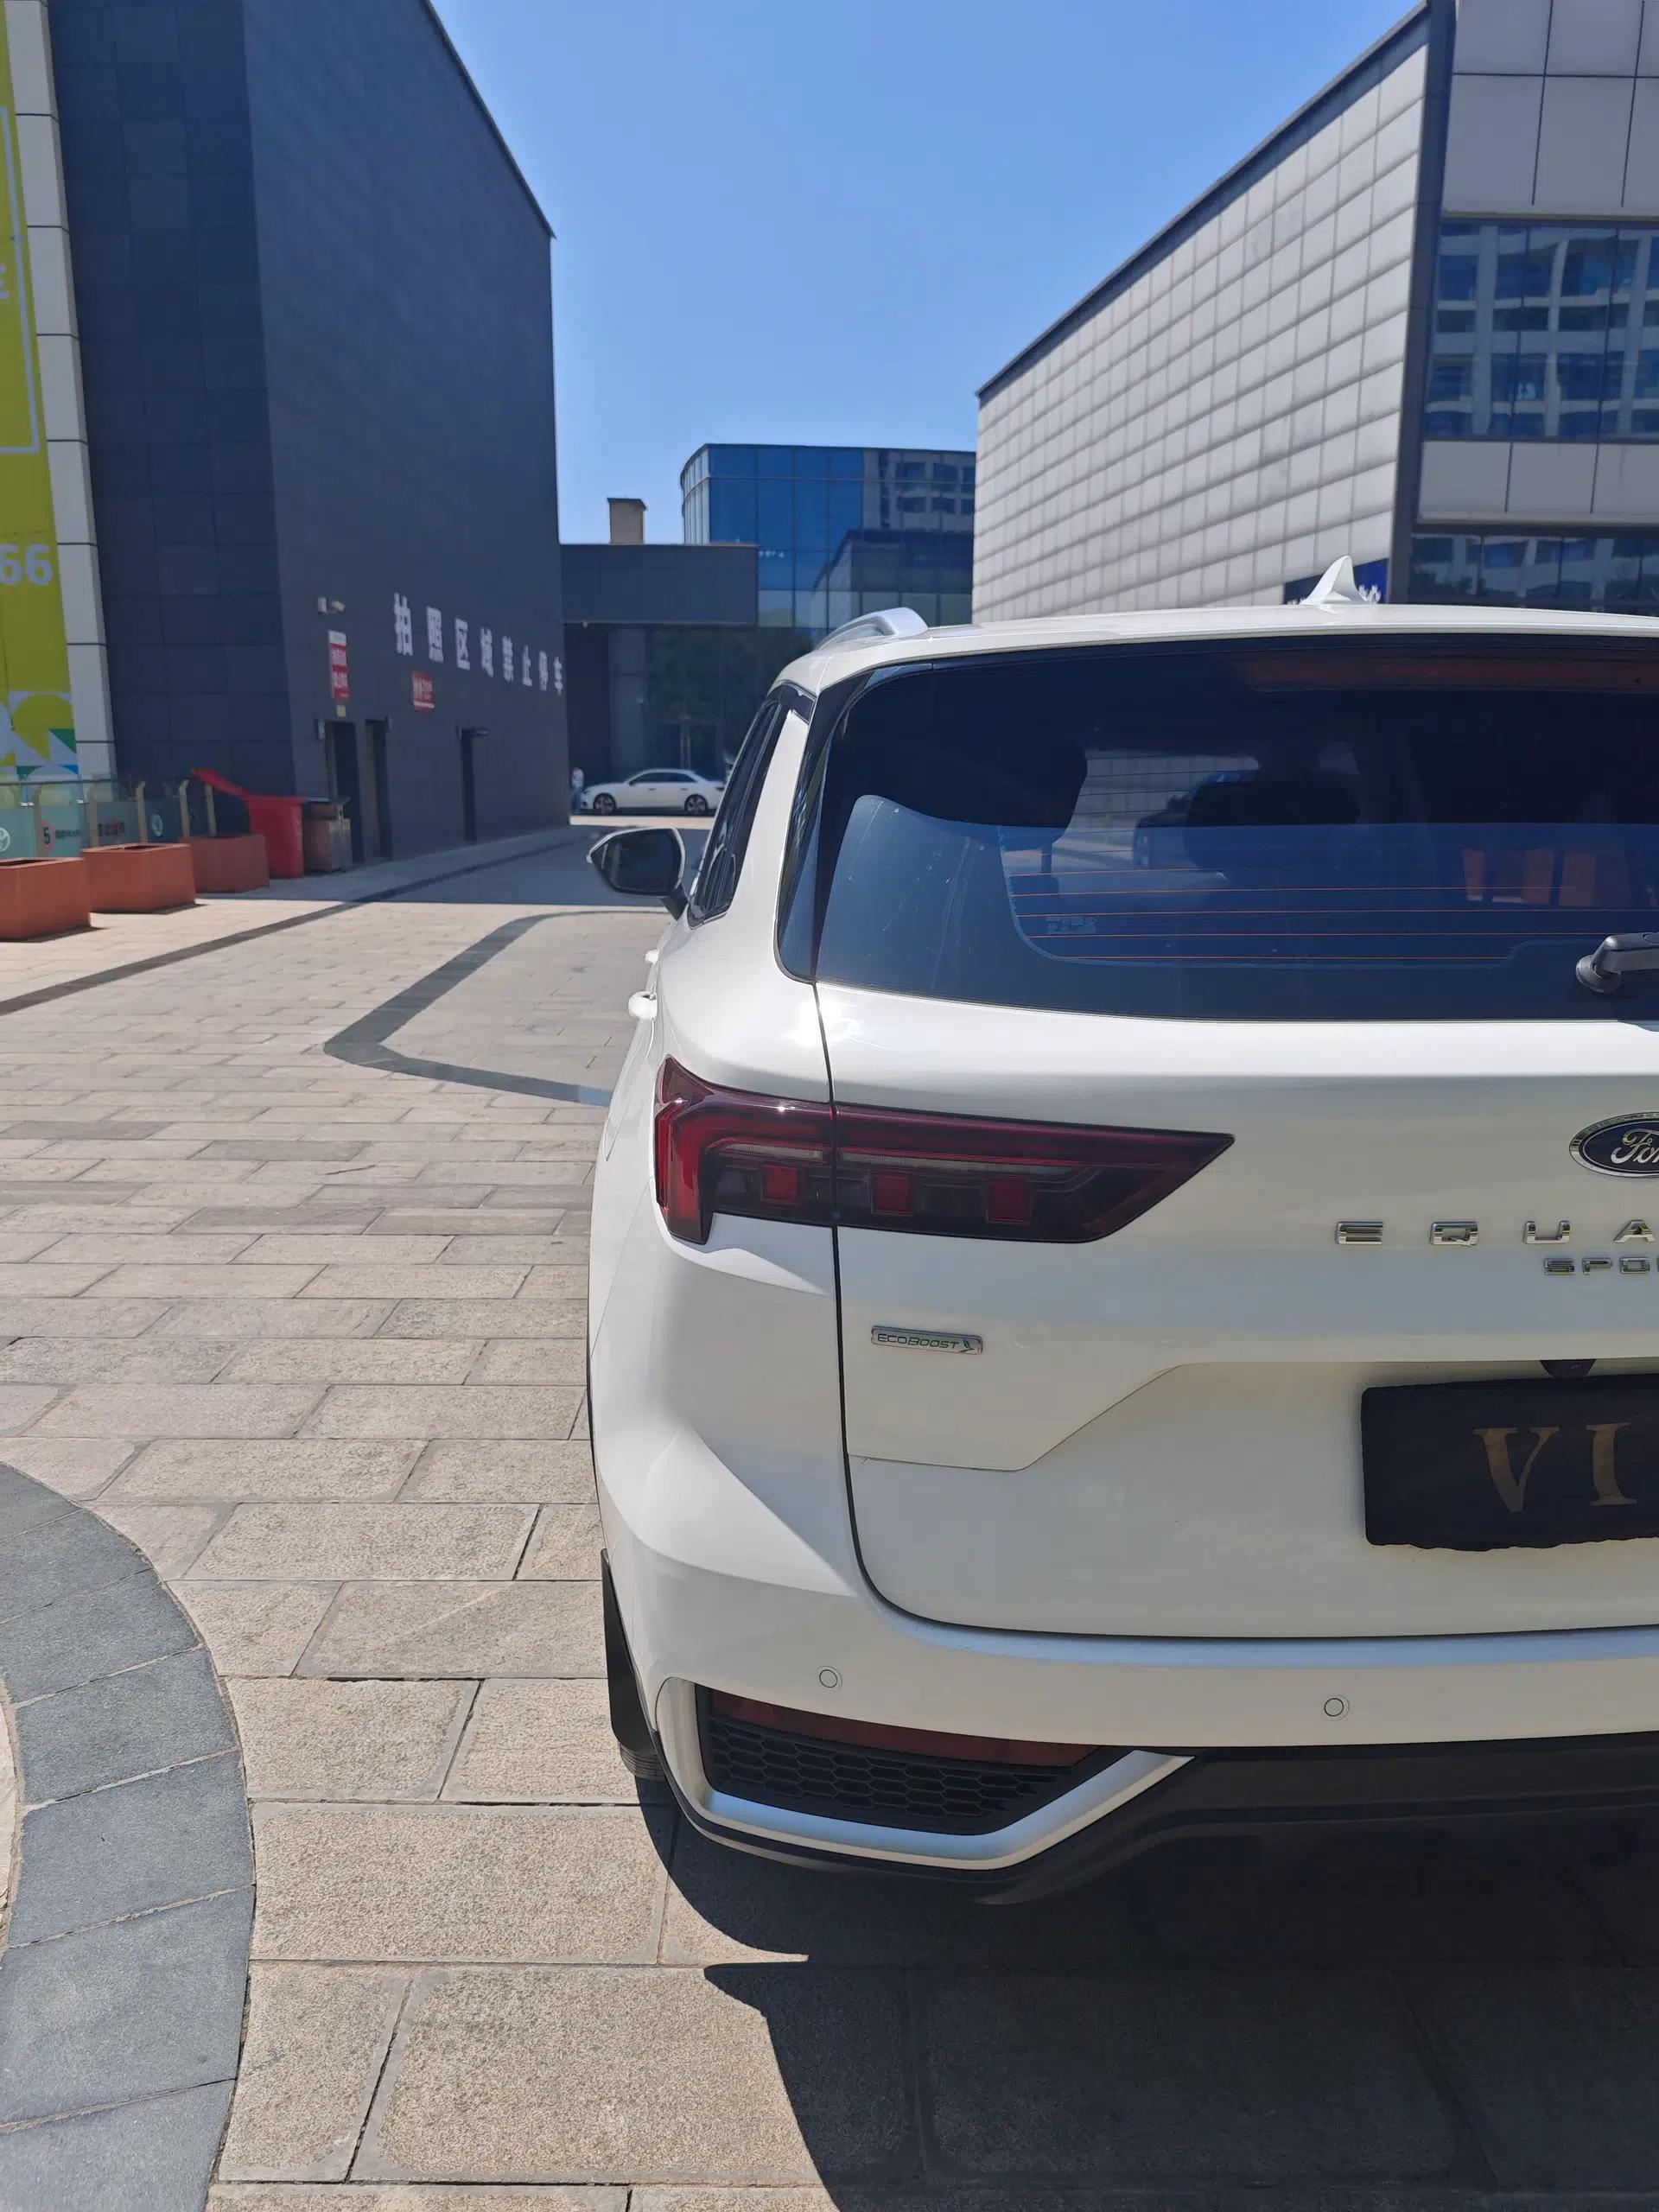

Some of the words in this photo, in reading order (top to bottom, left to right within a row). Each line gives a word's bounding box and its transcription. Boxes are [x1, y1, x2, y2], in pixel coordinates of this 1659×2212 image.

[0, 543, 53, 585] 66
[393, 592, 563, 696] 拍照区域禁止停车
[1335, 1219, 1656, 1246] EQUA
[1543, 1256, 1659, 1275] SPO
[877, 1333, 961, 1349] ECOBOOST
[1472, 1421, 1638, 1513] VI
